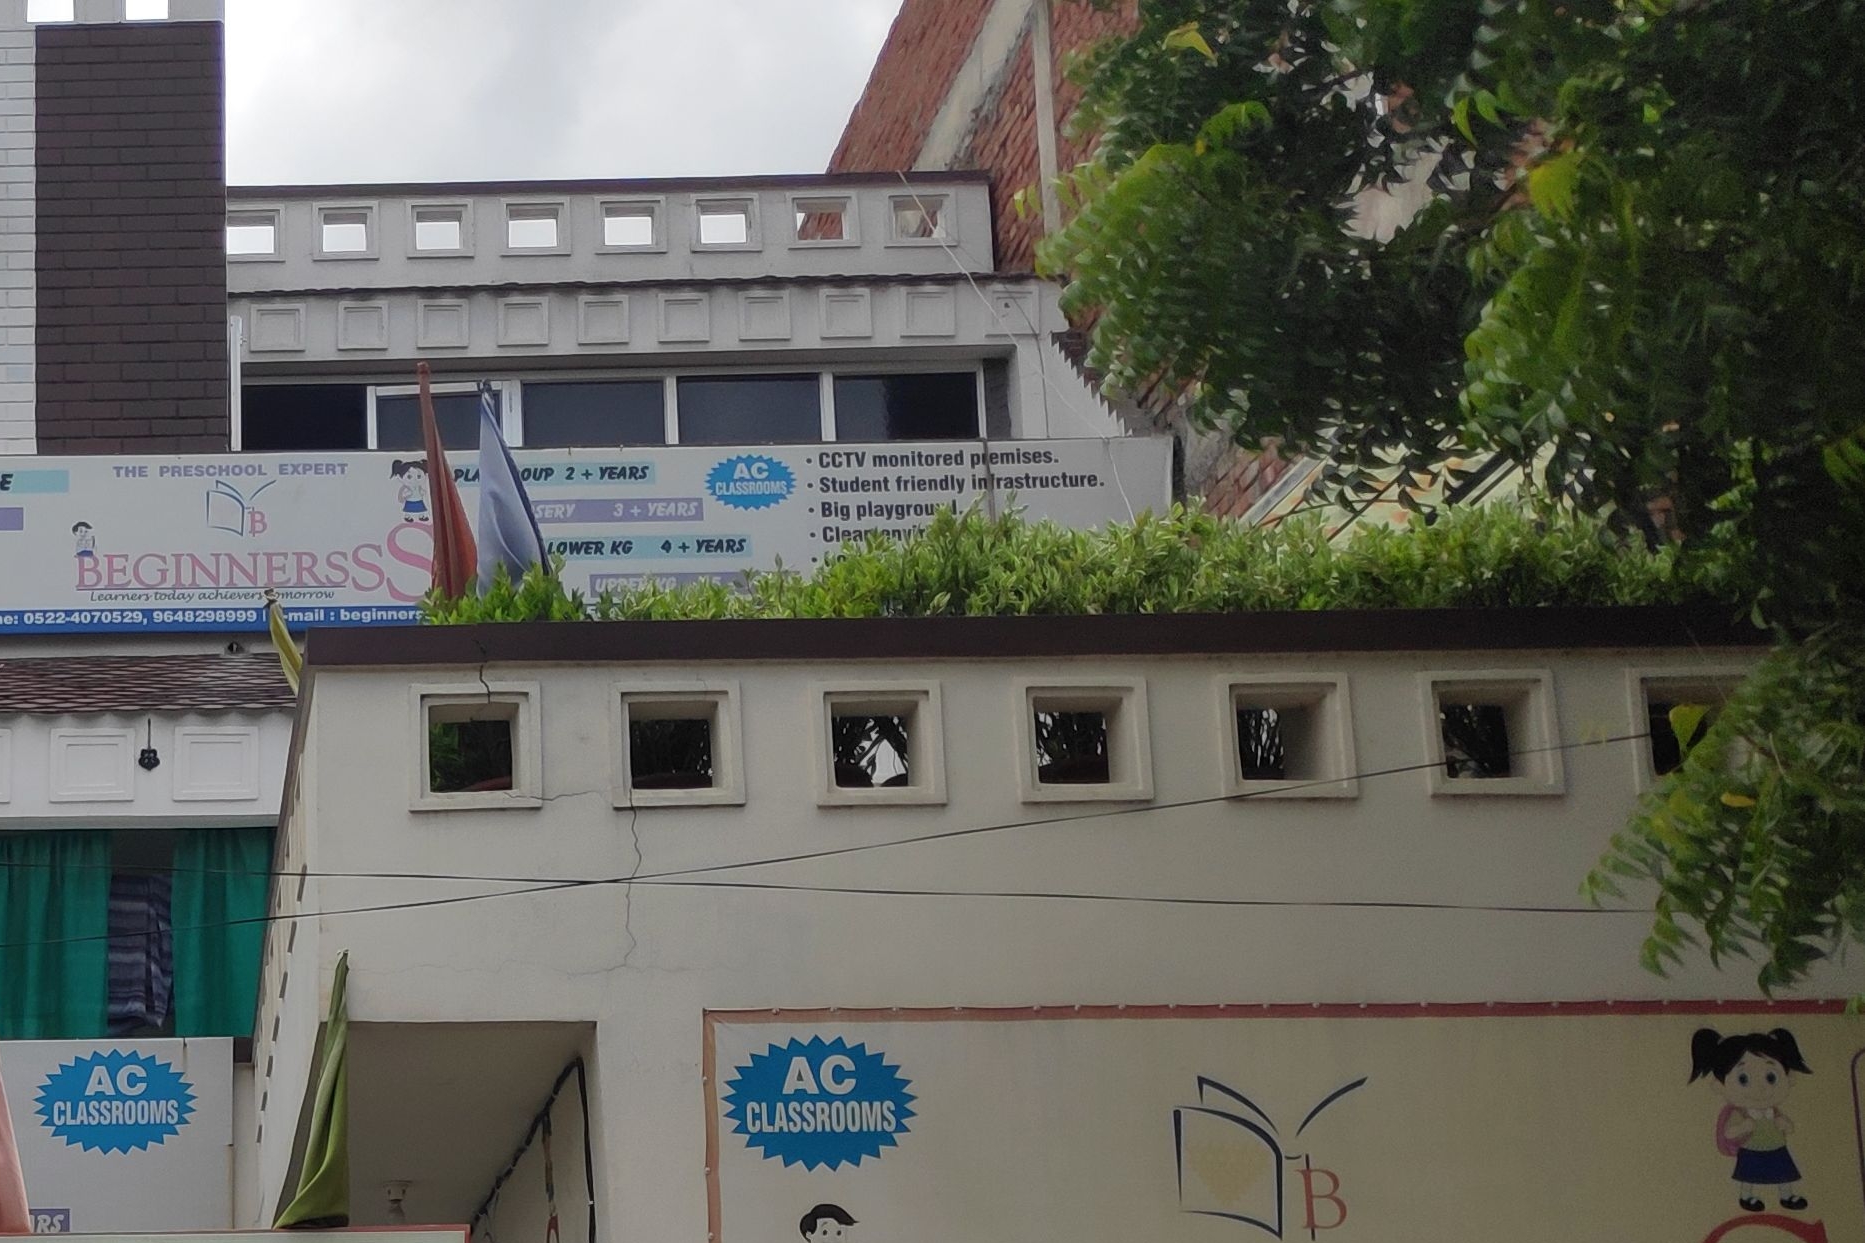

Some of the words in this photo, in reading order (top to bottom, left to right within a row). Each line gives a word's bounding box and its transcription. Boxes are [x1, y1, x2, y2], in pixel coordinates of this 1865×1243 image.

[819, 452, 866, 468] CCTV
[872, 450, 964, 468] monitored
[113, 466, 148, 478] THE
[159, 465, 267, 477] PRESCHOOL
[279, 463, 347, 475] EXPERT
[599, 467, 649, 480] YEARS
[734, 463, 769, 480] AC
[715, 480, 787, 496] CLASSROOMS
[819, 476, 889, 492] Student
[896, 475, 964, 494] friendly
[821, 502, 850, 520] Big
[610, 541, 633, 554] KG
[696, 539, 746, 553] YEARS
[76, 522, 436, 602] BEGINNERSSS
[24, 611, 147, 627] 0522-4070529,
[153, 610, 256, 622] 9648298999
[85, 1065, 147, 1095] AC
[782, 1055, 856, 1095] AC
[53, 1100, 178, 1125] CLASSROOMS
[746, 1101, 896, 1133] CLASSROOMS
